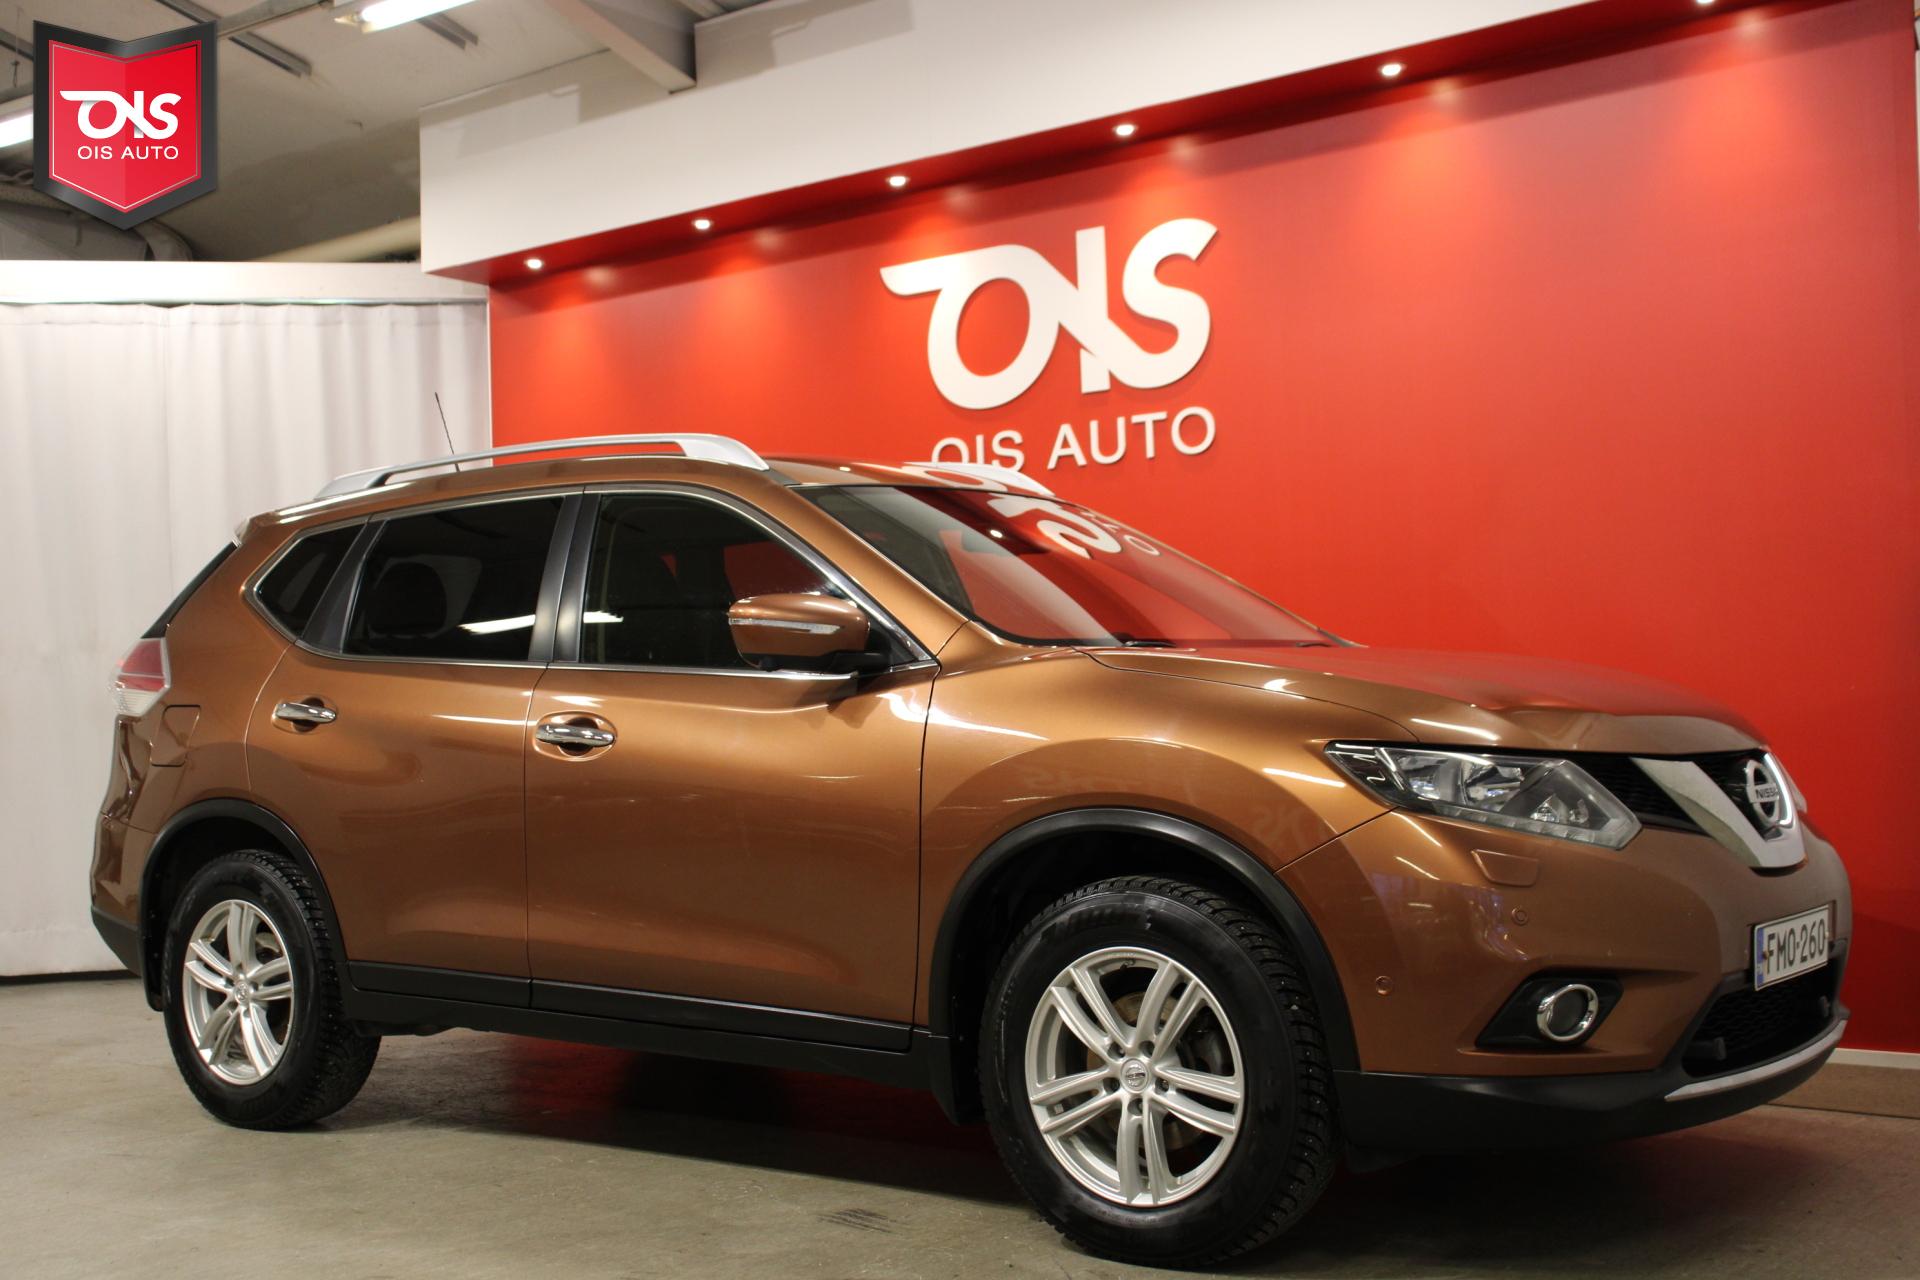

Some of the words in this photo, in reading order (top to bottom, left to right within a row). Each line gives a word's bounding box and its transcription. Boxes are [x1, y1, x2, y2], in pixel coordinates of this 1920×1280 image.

[1047, 406, 1217, 470] AUTO
[1755, 786, 1779, 799] NISS
[1766, 918, 1826, 975] FMO-260
